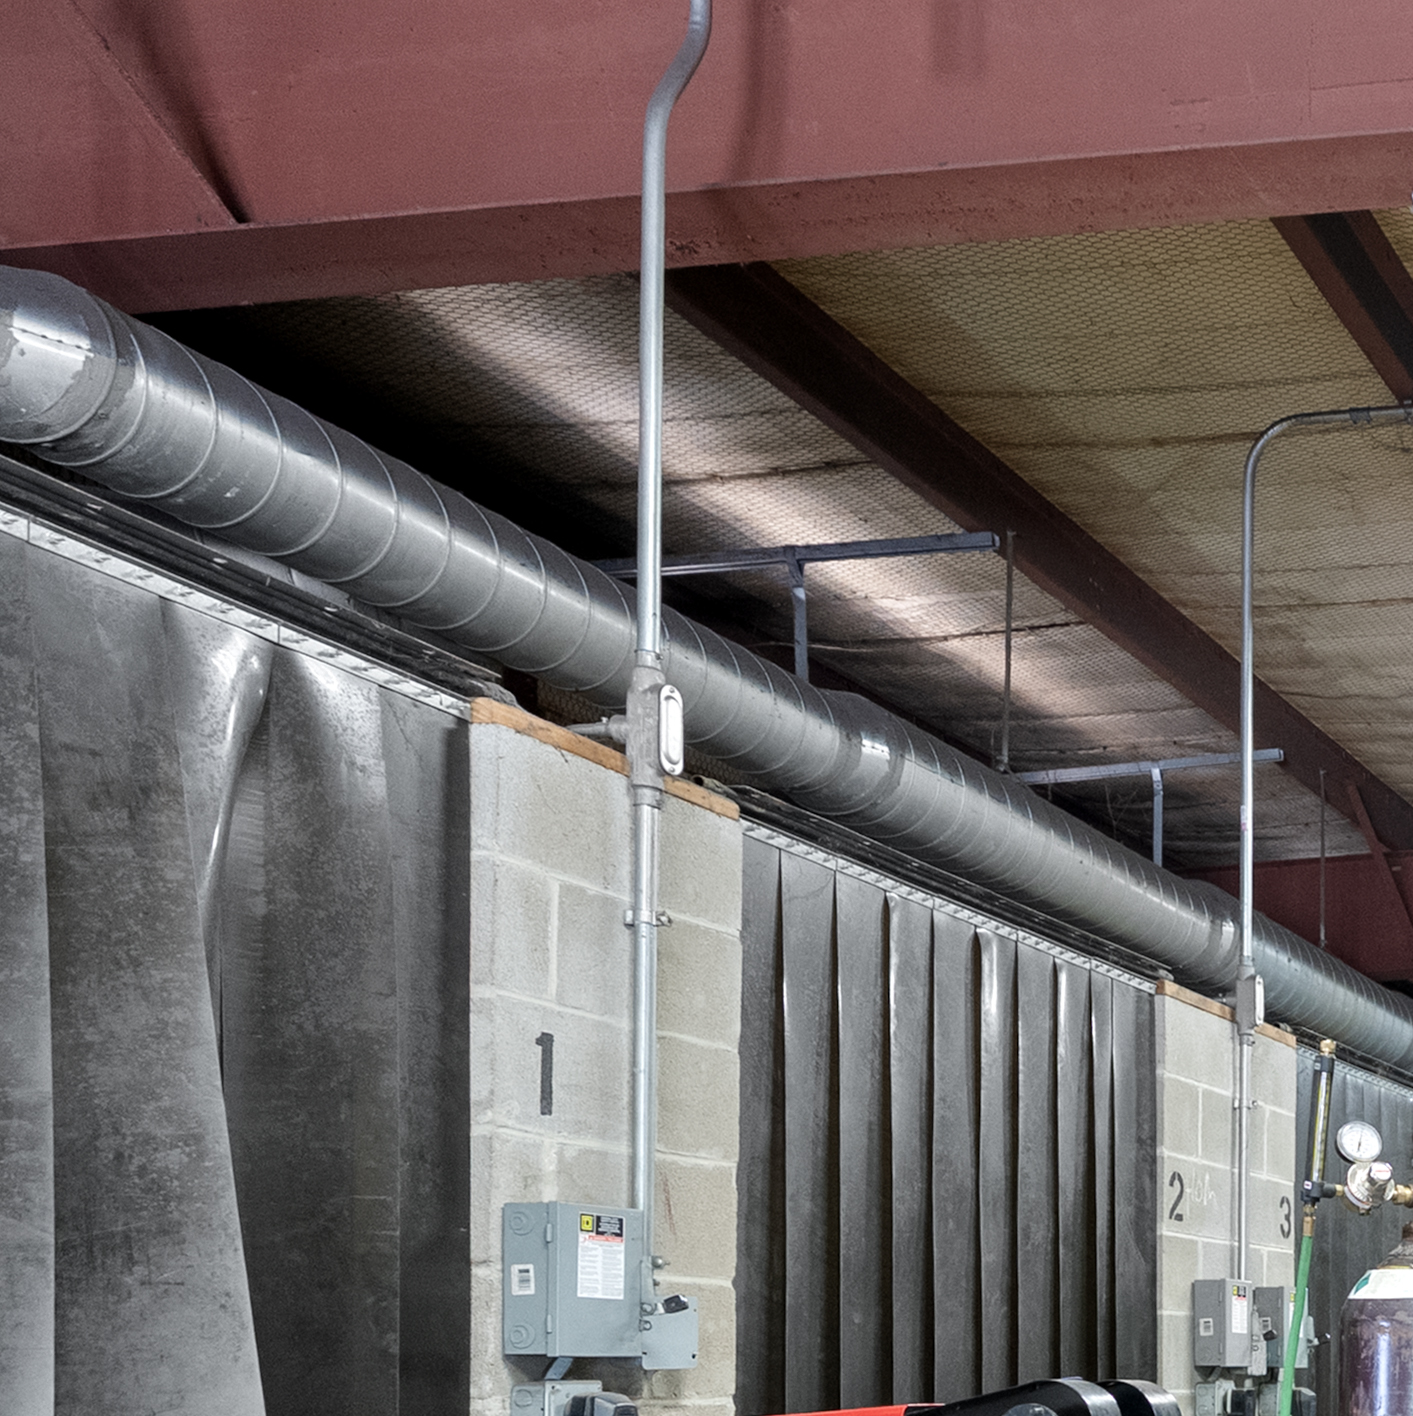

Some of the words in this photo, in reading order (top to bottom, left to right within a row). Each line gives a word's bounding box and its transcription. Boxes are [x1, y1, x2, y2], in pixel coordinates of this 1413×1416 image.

[534, 1031, 555, 1116] 1
[1168, 1171, 1184, 1222] 2
[1279, 1195, 1291, 1240] 3
